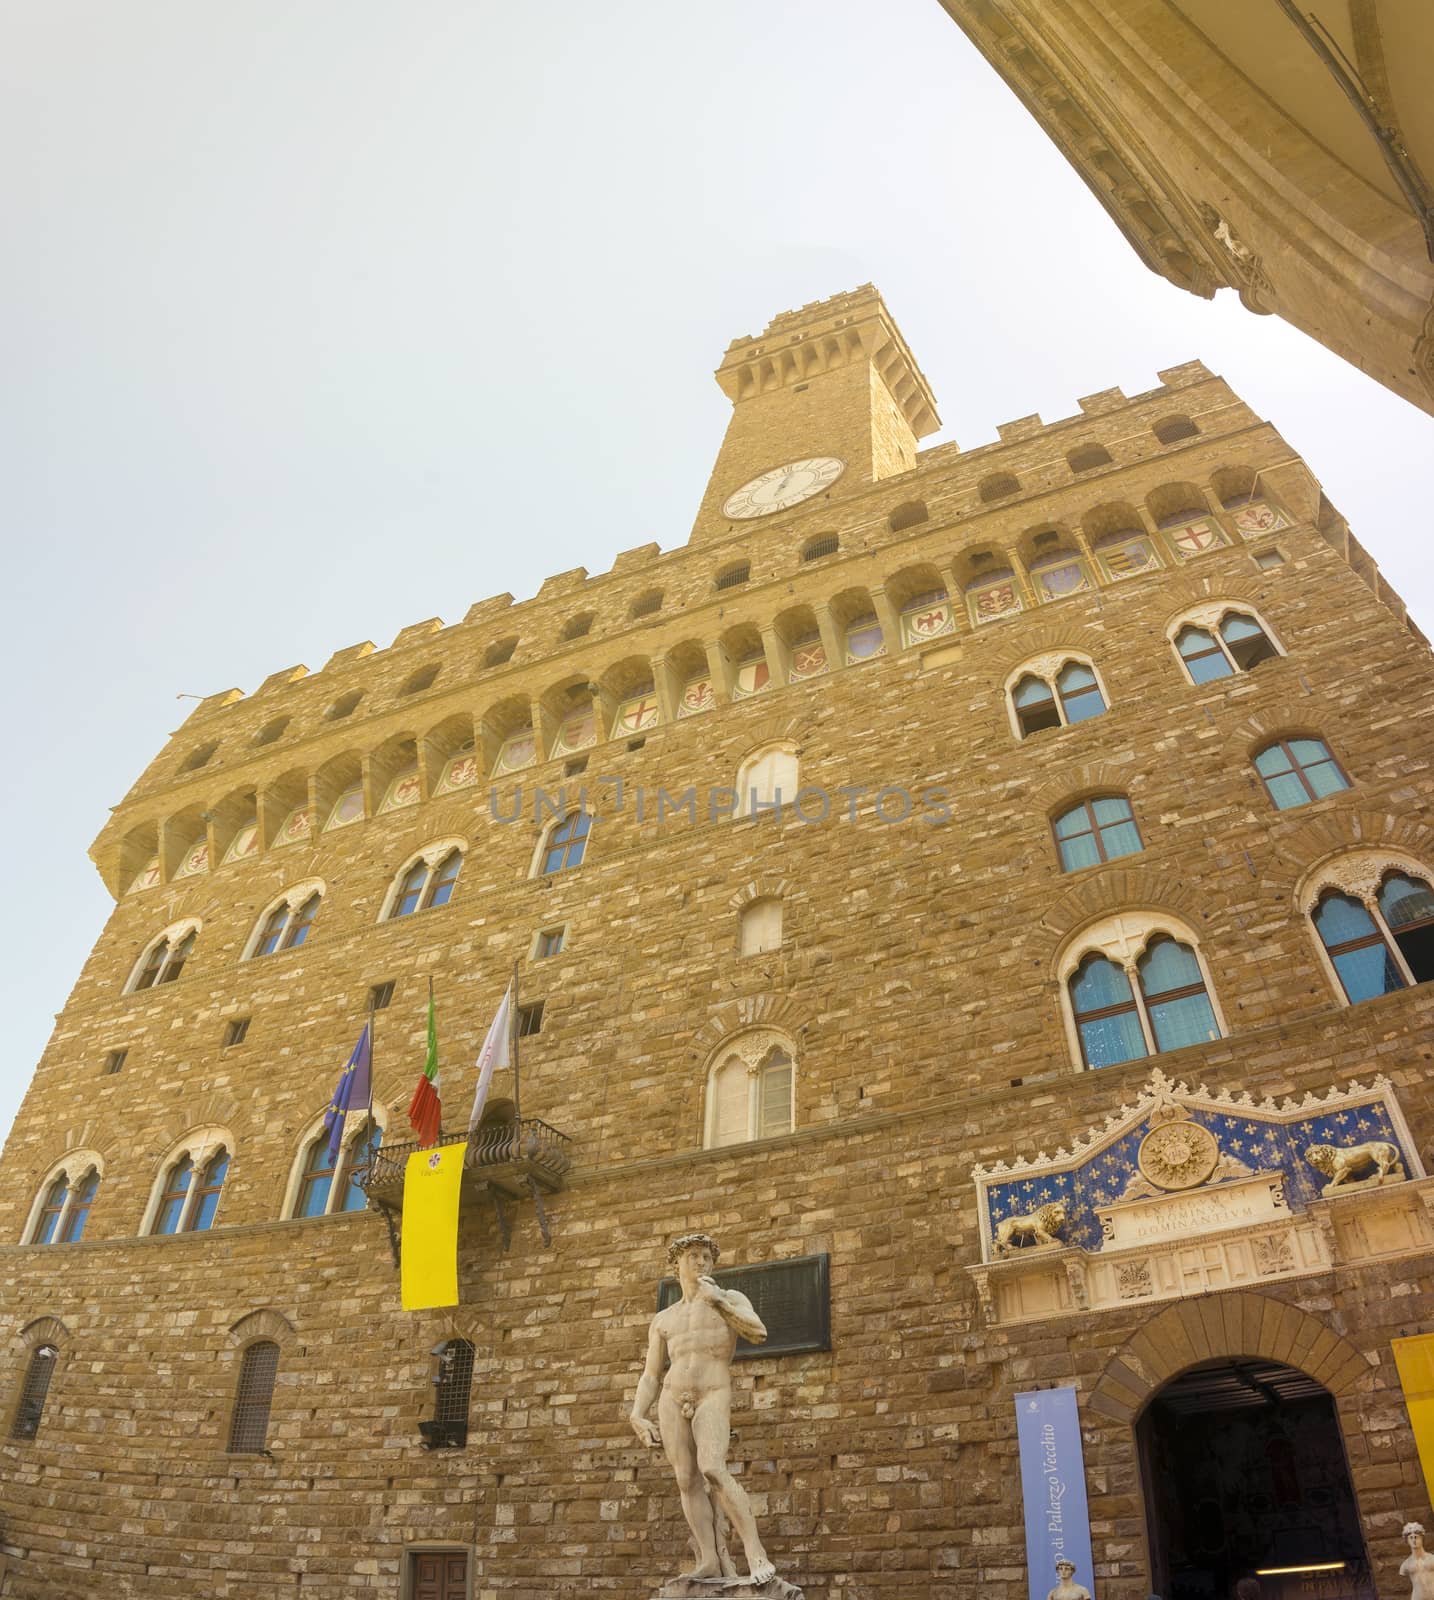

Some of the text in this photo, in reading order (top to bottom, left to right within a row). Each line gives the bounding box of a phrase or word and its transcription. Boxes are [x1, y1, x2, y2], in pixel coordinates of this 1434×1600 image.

[1040, 1423, 1057, 1475] Vecchio
[1046, 1476, 1066, 1533] Palazzo
[1051, 1537, 1064, 1550] di
